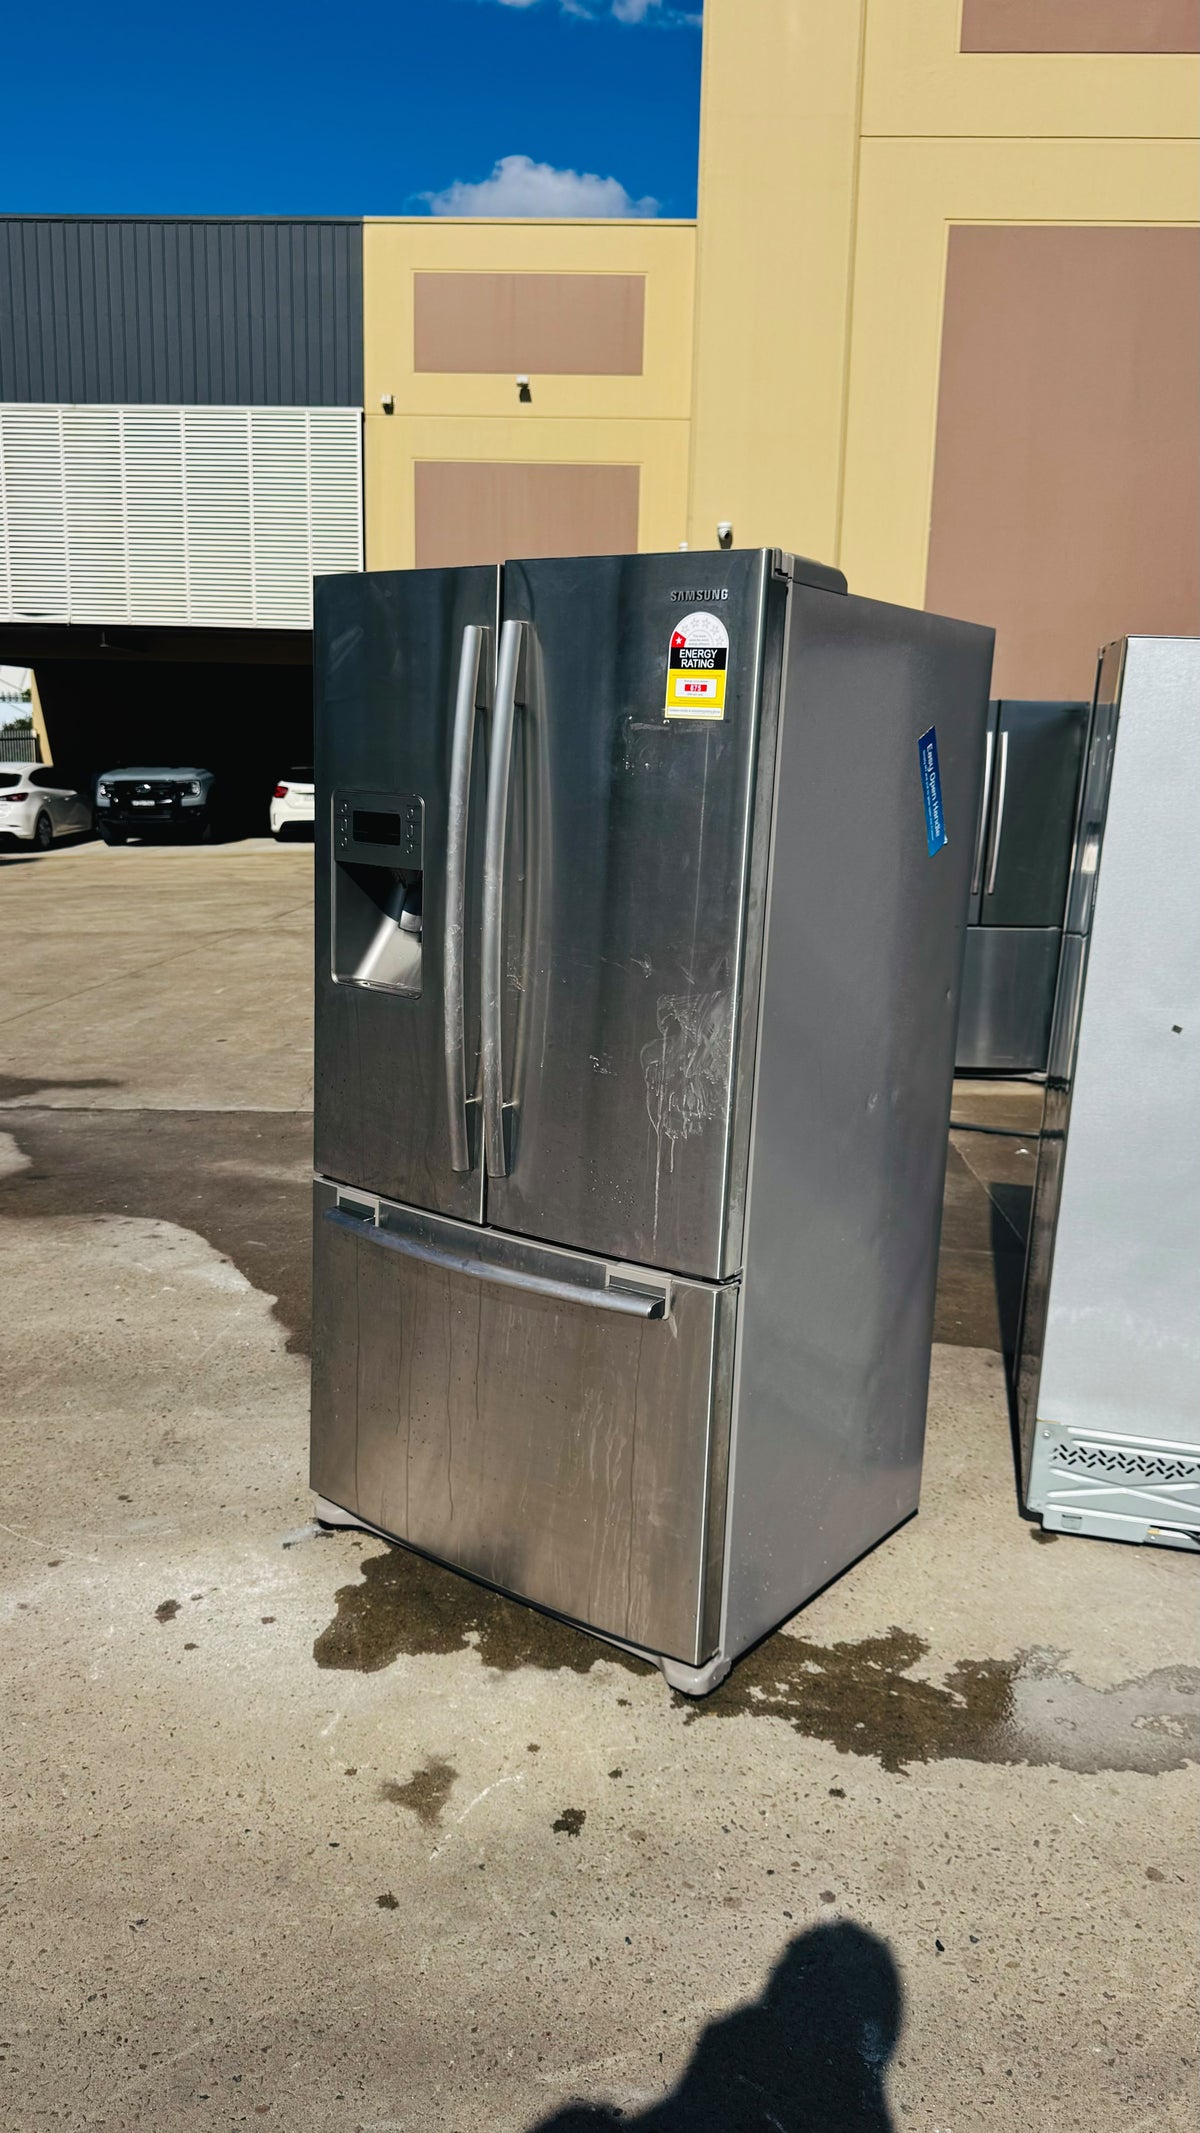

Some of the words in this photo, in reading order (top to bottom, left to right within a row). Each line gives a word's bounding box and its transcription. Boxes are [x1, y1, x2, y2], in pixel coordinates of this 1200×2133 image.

[670, 588, 729, 602] SAMSUNG
[679, 648, 718, 659] ENERGY
[681, 659, 715, 669] RATING
[926, 743, 934, 772] Easy
[933, 800, 941, 838] Handle
